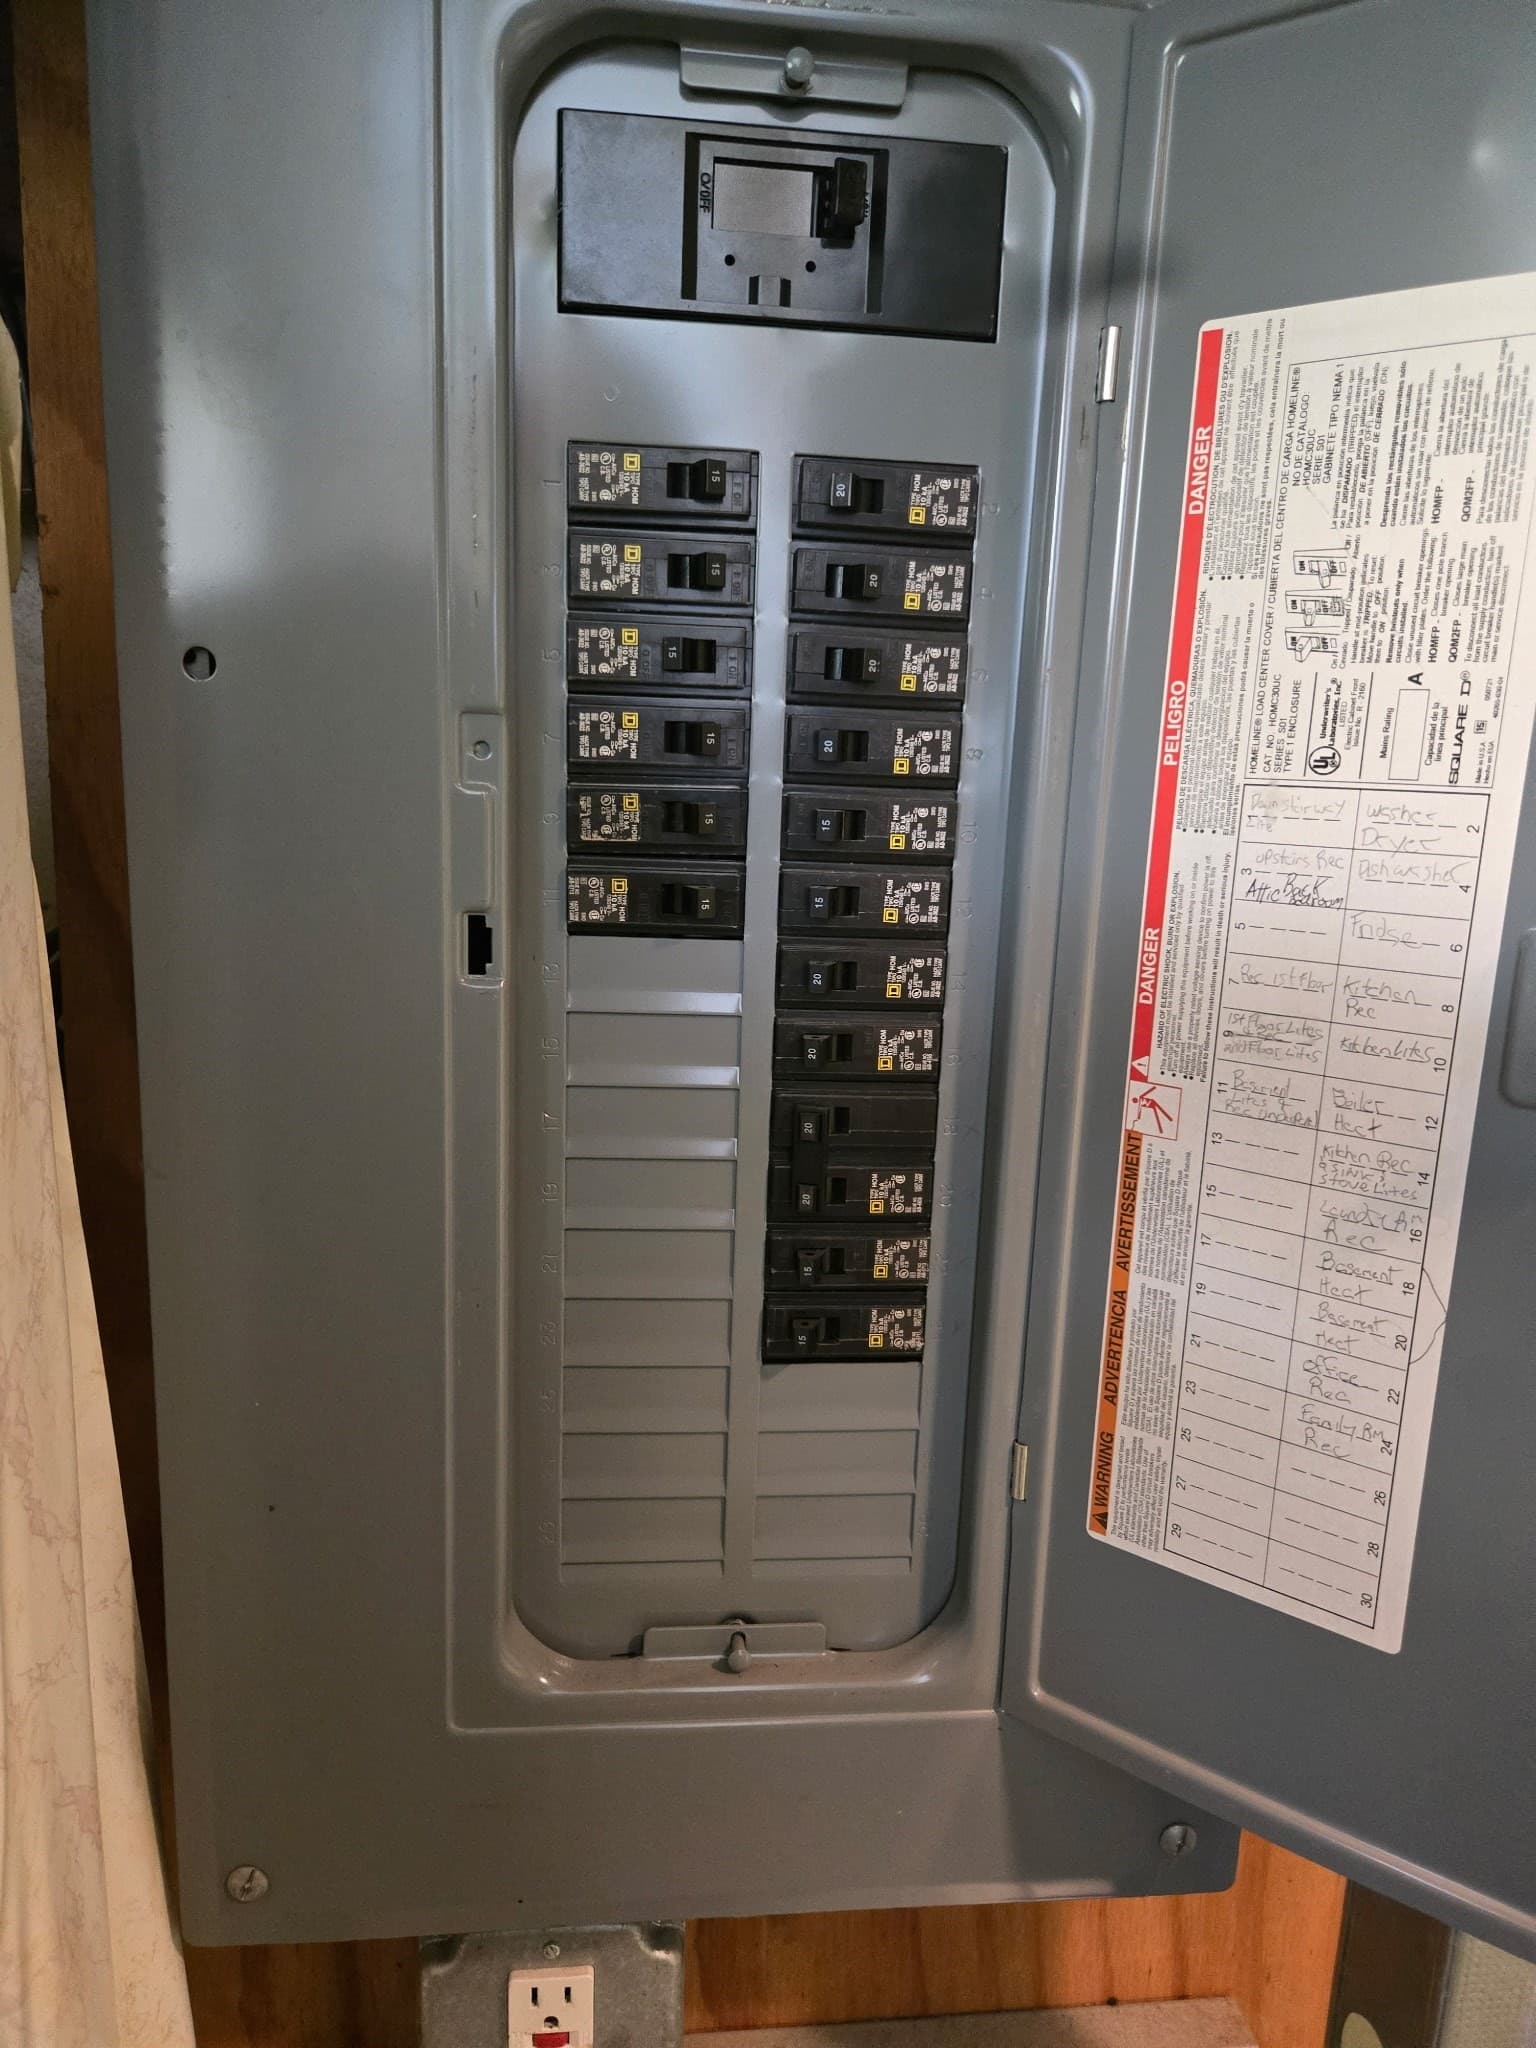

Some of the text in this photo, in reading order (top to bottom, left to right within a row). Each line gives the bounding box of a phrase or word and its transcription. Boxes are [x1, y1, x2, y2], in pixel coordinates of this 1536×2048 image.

[1332, 371, 1343, 401] NEMA
[1328, 404, 1339, 428] TIPO
[1282, 431, 1294, 467] CARGA
[1302, 428, 1316, 485] HOMC30UC
[1294, 454, 1303, 468] DE
[1312, 434, 1325, 484] SERIE S01
[1322, 432, 1336, 483] GABINETE
[712, 470, 720, 483] 15
[1188, 425, 1211, 514] DANGER
[1280, 469, 1290, 483] DE
[1292, 471, 1301, 486] NO
[836, 484, 846, 497] 20
[1430, 485, 1444, 523] HOMFP
[1460, 476, 1476, 522] QOM2FP
[1275, 486, 1288, 529] CENTRO
[1273, 531, 1283, 550] DEL
[712, 563, 720, 576] 15
[908, 562, 916, 578] HOM
[869, 574, 878, 588] 20
[1268, 554, 1281, 603] CUBIERTA
[1263, 611, 1274, 645] COVER
[1427, 625, 1441, 662] HOMFP
[1447, 619, 1463, 662] QOM2FP
[668, 647, 676, 658] 15
[869, 660, 876, 672] 20
[1259, 649, 1270, 688] CENTER
[1406, 671, 1423, 685] A
[1256, 690, 1266, 715] LOAD
[1268, 673, 1281, 726] HOMC30UC
[1287, 679, 1301, 737] ENCLOSURE
[1163, 680, 1185, 765] PELIGRO
[1436, 706, 1449, 740] principal
[706, 733, 715, 745] 15
[1379, 707, 1394, 758] Mains Rating
[824, 740, 832, 752] 20
[1273, 717, 1287, 772] SERIES S01
[1423, 722, 1438, 765] Capacidad
[1447, 703, 1469, 783] SQUARE
[1283, 749, 1293, 773] TYPE
[705, 814, 713, 825] 15
[822, 820, 830, 831] 15
[1467, 825, 1479, 834] 2
[1241, 868, 1252, 876] 3
[701, 899, 710, 910] 15
[815, 897, 824, 909] 15
[1169, 914, 1175, 925] OR
[1235, 922, 1246, 930] 5
[1450, 944, 1462, 952] 6
[1139, 926, 1159, 1005] DANGER
[813, 974, 822, 986] 20
[1160, 974, 1169, 1008] ELECTRIC
[1159, 1009, 1165, 1019] OF
[1442, 1004, 1454, 1013] 8
[1156, 1020, 1164, 1048] HAZARD
[808, 1048, 817, 1060] 20
[1433, 1058, 1447, 1072] 10
[1218, 1082, 1228, 1094] 11
[804, 1122, 812, 1134] 20
[1425, 1116, 1439, 1130] 12
[1211, 1132, 1223, 1144] 13
[1418, 1172, 1430, 1186] 14
[1206, 1184, 1217, 1198] 15
[802, 1194, 810, 1206] 20
[1114, 1132, 1142, 1271] AVERTISSEMENT
[1200, 1233, 1212, 1246] 17
[1409, 1229, 1422, 1244] 16
[804, 1266, 812, 1276] 15
[1196, 1282, 1206, 1295] 19
[1402, 1282, 1415, 1295] 18
[799, 1336, 806, 1344] 15
[1102, 1287, 1127, 1406] ADVERTENCIA
[1190, 1333, 1202, 1347] 21
[1394, 1335, 1408, 1350] 20
[1186, 1380, 1196, 1394] 23
[1388, 1389, 1400, 1404] 22
[1180, 1427, 1192, 1442] 25
[1380, 1441, 1392, 1456] 24
[1093, 1429, 1113, 1509] WARNING
[1176, 1476, 1186, 1490] 27
[1374, 1490, 1386, 1506] 26
[1171, 1524, 1182, 1538] 29
[1368, 1542, 1380, 1558] 28
[1360, 1593, 1372, 1608] 30
